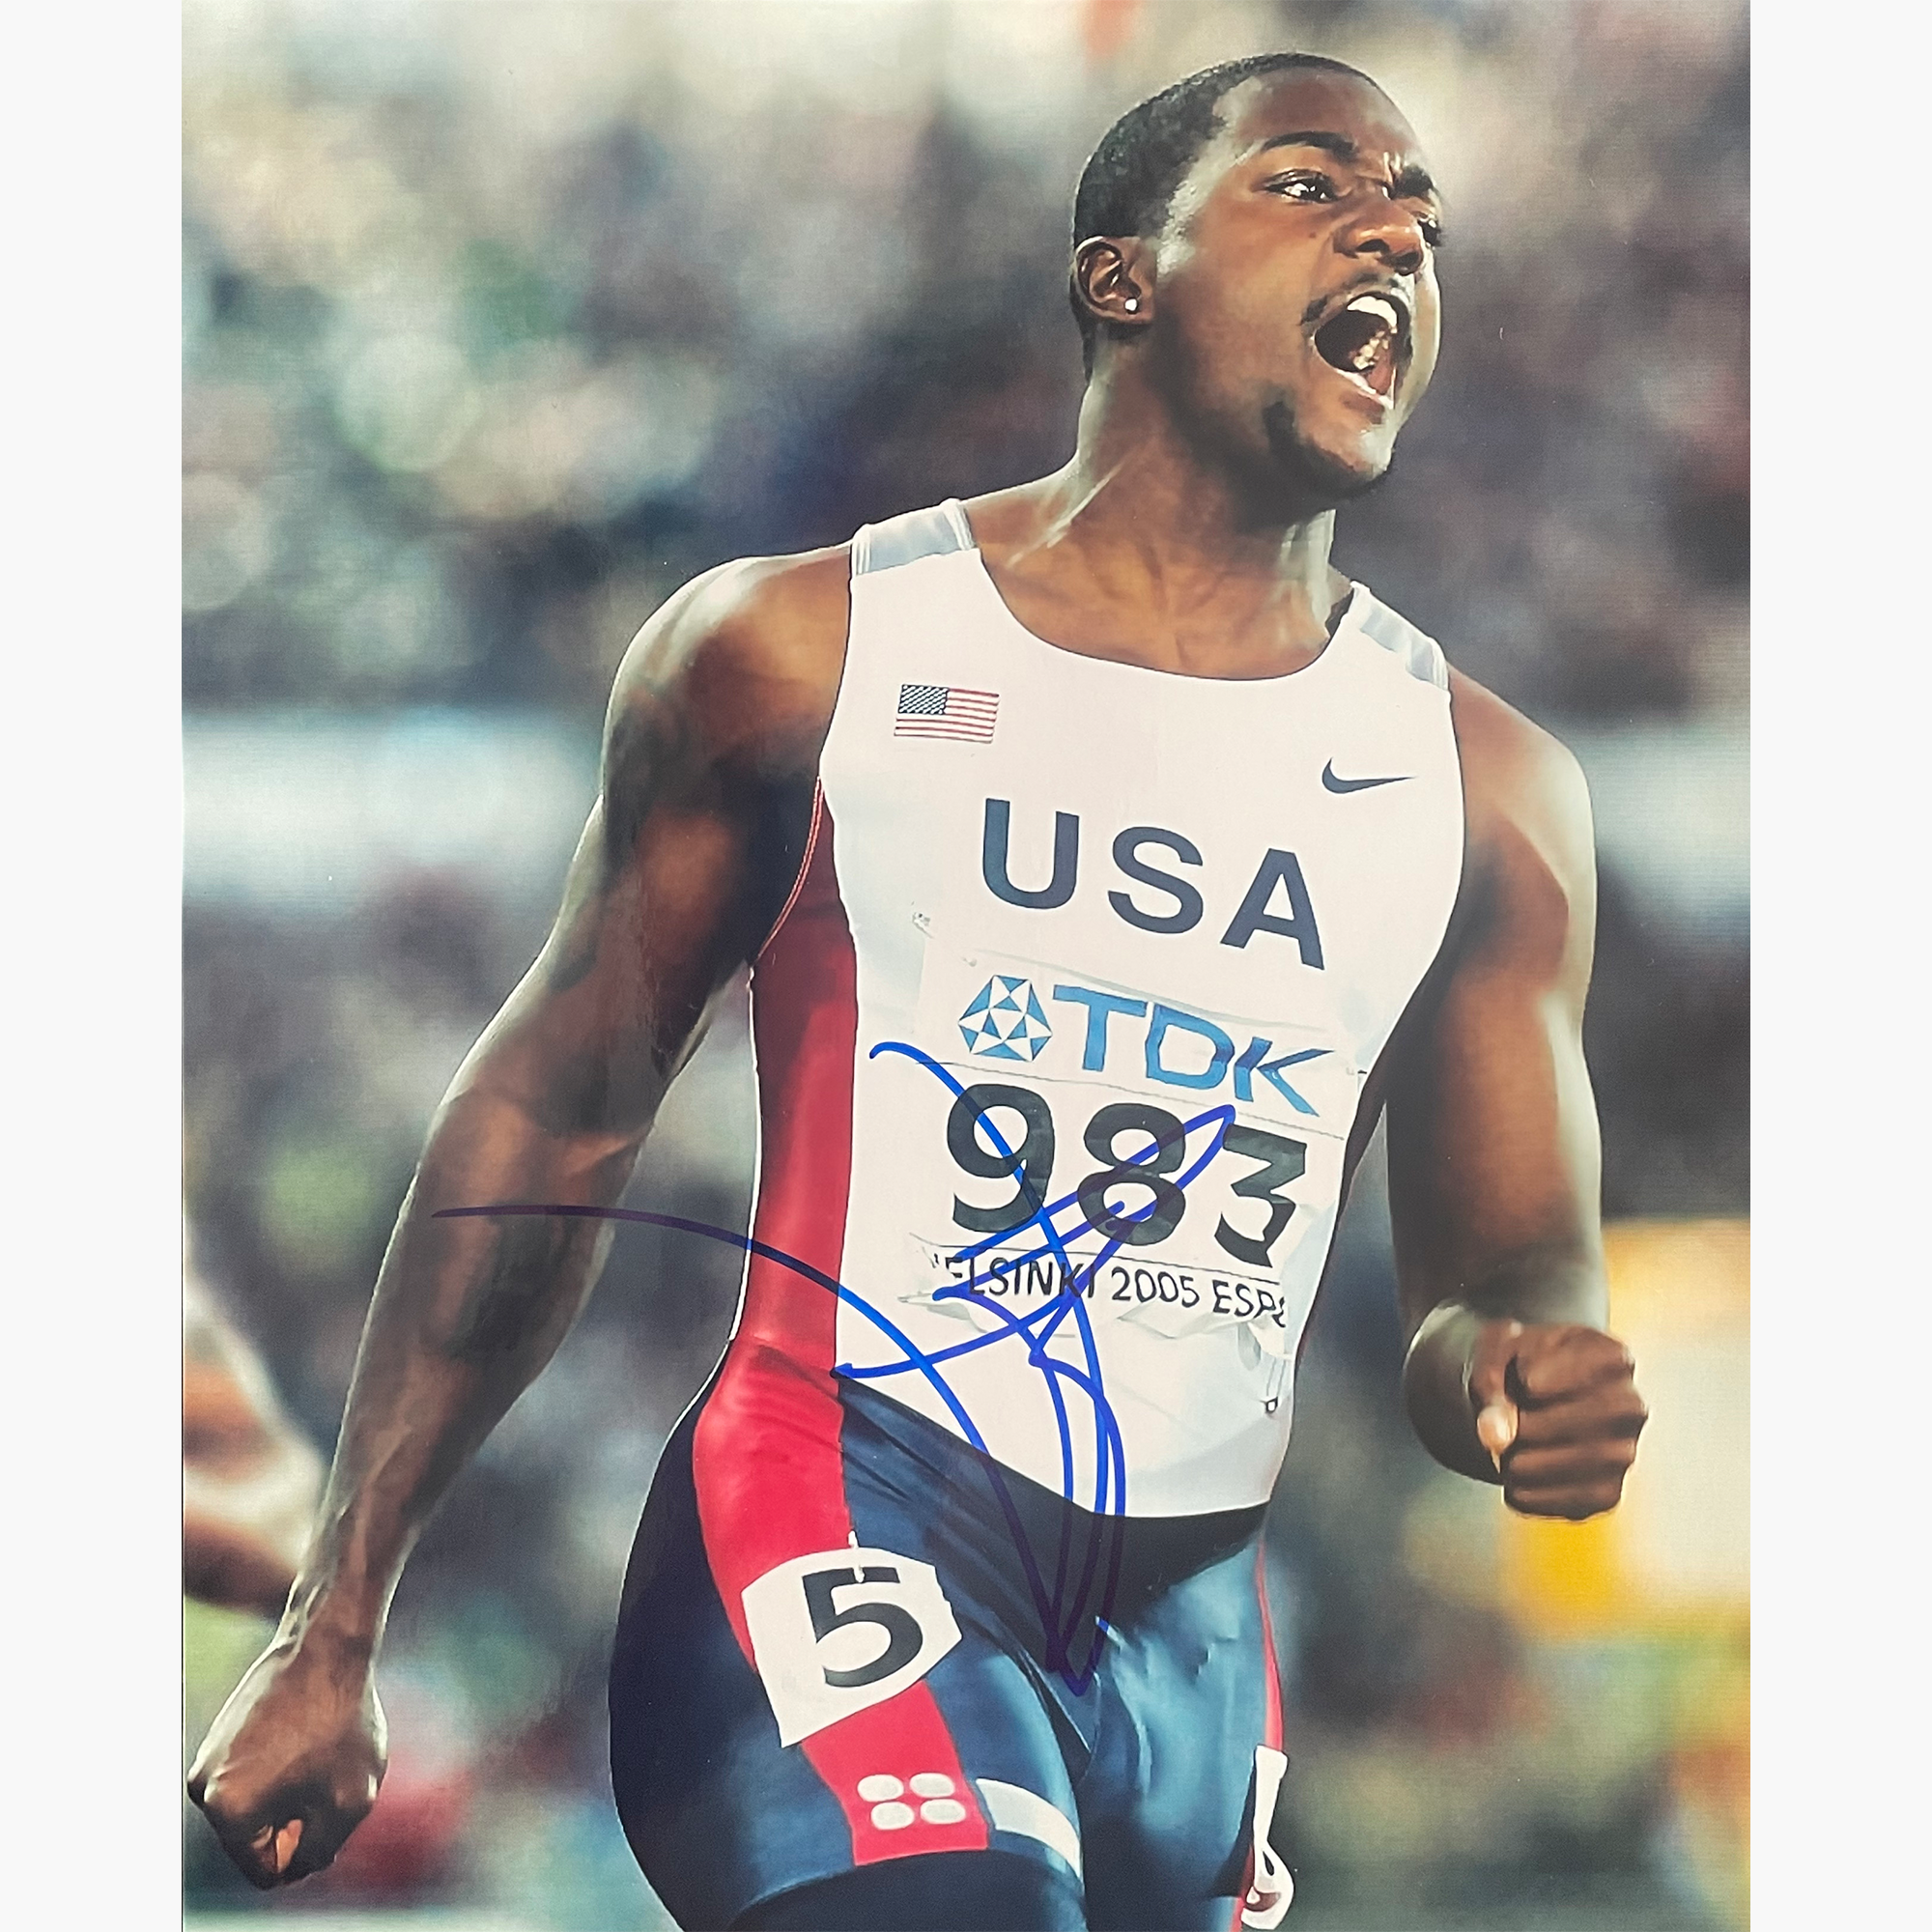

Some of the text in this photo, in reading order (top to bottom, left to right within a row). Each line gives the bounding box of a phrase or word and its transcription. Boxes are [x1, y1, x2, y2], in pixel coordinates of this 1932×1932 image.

[982, 798, 1324, 970] USA
[1053, 984, 1335, 1117] TDK
[947, 1084, 1307, 1267] 983
[933, 1253, 1097, 1298] ELSINKI
[1111, 1268, 1200, 1307] 2005
[802, 1566, 923, 1689] 5
